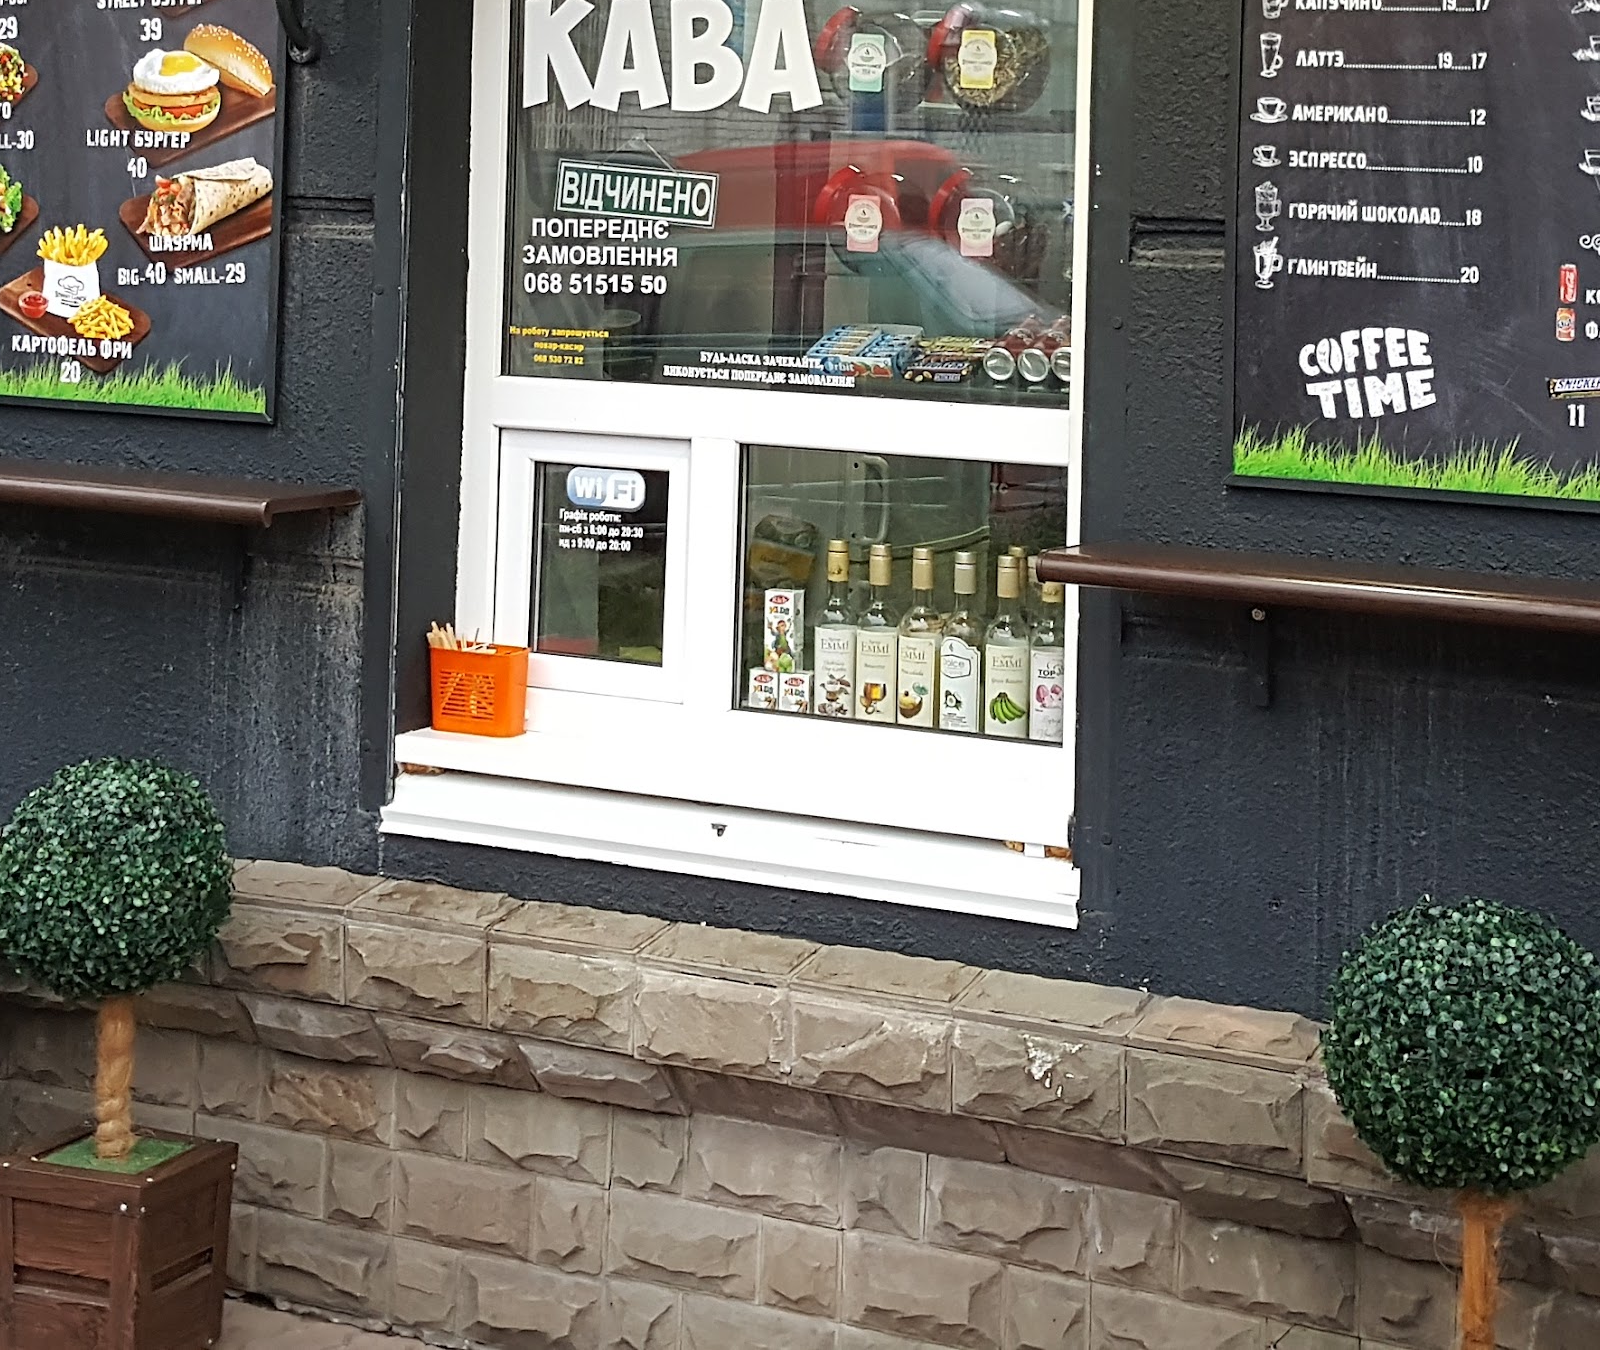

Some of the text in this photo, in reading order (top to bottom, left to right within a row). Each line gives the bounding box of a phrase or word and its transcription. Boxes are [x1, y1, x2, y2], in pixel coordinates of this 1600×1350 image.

[139, 17, 163, 42] 39
[86, 128, 191, 150] LIGHT БУРГЕР
[126, 157, 149, 178] 40
[562, 171, 711, 217] ВІДЧИНЕНО
[1289, 200, 1358, 221] ГОРЯЧИЙ
[531, 217, 669, 242] ПОПЕРЕДНЄ
[149, 233, 214, 252] ШАУРМА
[522, 245, 678, 267] ЗАМОВЛЕННЯ
[524, 273, 667, 295] 068 51515 50
[11, 334, 133, 359] КАРТОФЕЛЬ ФРИ
[1298, 326, 1433, 376] COFFEE
[59, 362, 81, 383] 20
[1305, 368, 1437, 419] TIME
[1568, 404, 1585, 427] 11
